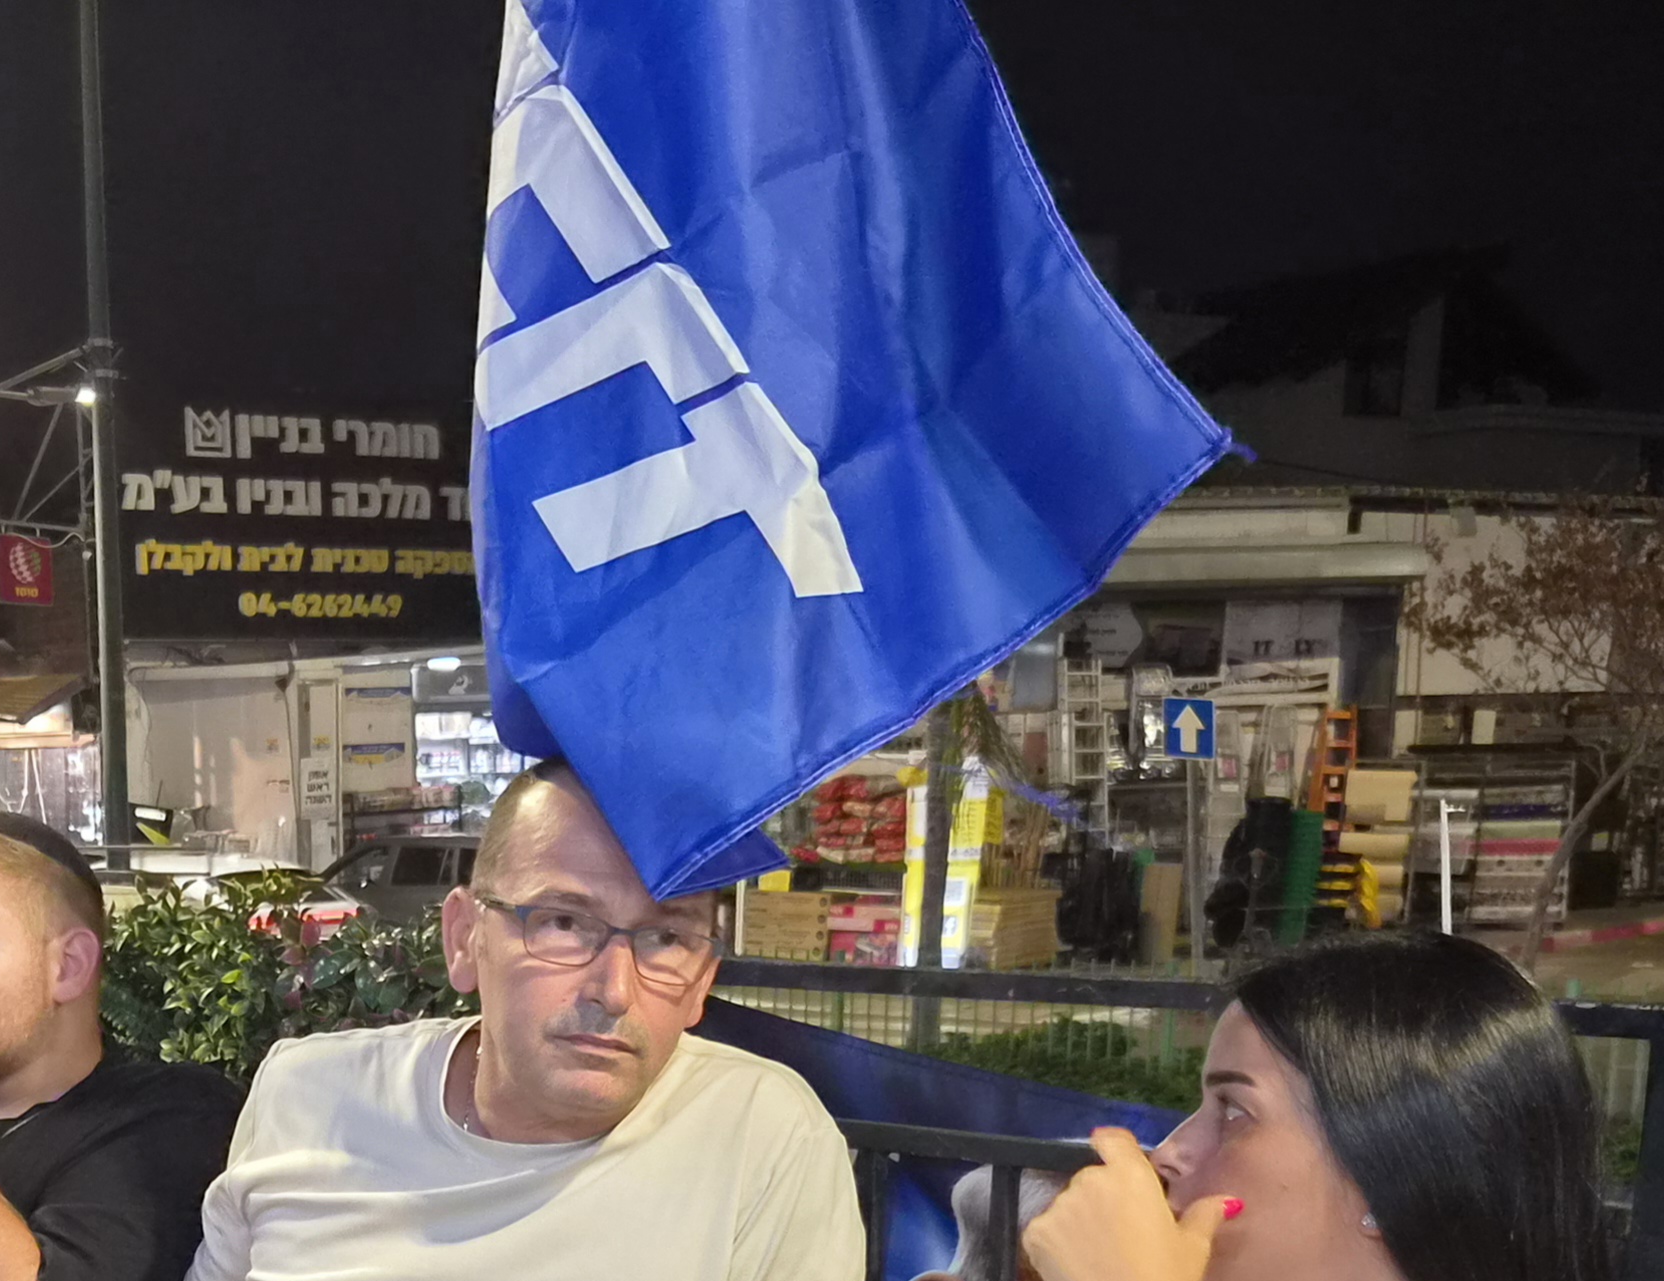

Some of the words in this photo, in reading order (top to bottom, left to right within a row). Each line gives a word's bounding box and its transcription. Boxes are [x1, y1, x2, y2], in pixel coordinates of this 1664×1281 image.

[235, 413, 325, 459] בניין
[332, 419, 440, 460] חומרי
[235, 477, 322, 516] ובניו
[331, 477, 431, 520] מלכה
[135, 539, 232, 576] ולקבלן
[237, 542, 304, 572] לבית
[238, 592, 403, 618] 04-6262449
[307, 783, 329, 793] ראש
